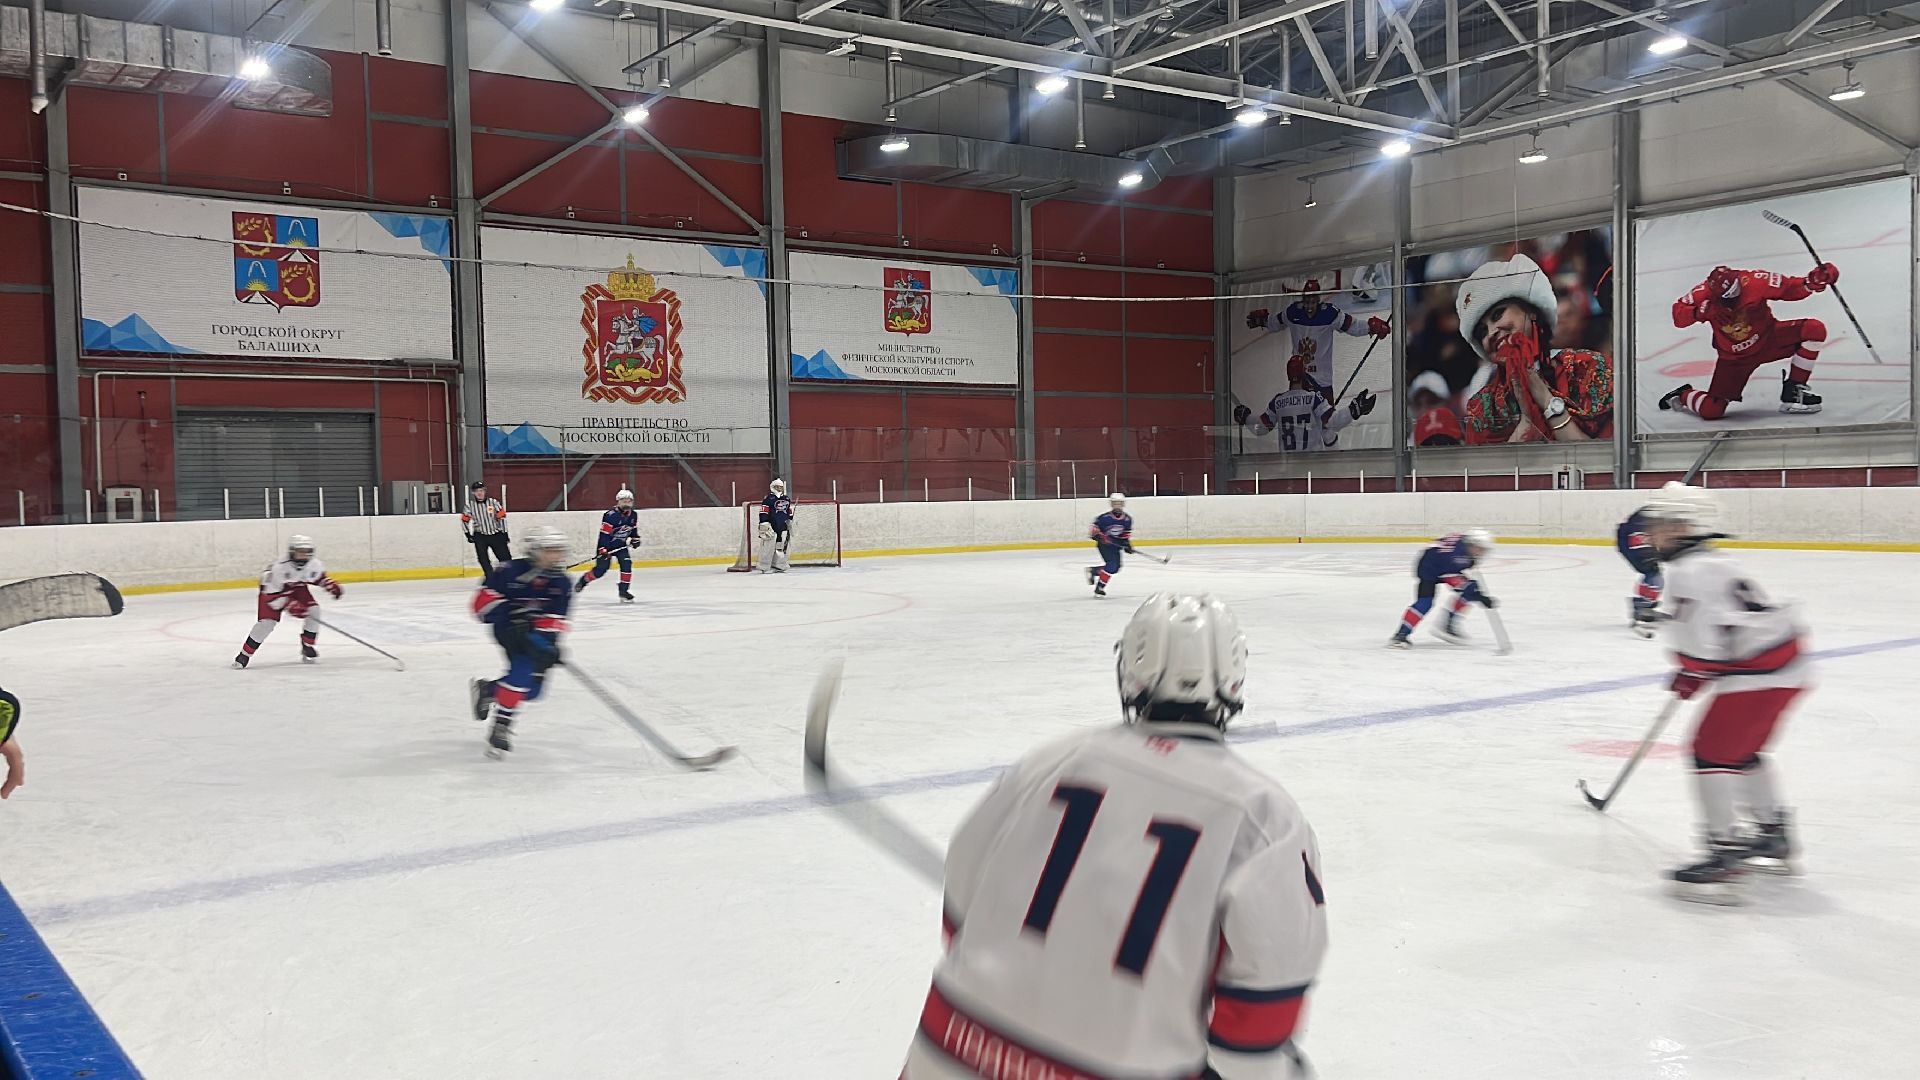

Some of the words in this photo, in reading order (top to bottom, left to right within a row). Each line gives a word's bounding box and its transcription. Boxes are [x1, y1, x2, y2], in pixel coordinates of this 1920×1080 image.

[211, 324, 297, 338] ГОРОДСКОЙ
[300, 328, 345, 340] ОКРУГ
[238, 340, 321, 353] БАЛАШИХА
[878, 343, 941, 354] МИНИСТЕРСТВО
[841, 353, 896, 364] ФИЗИЧЕСКОЙ
[897, 355, 937, 366] КУЛЬТУРЫ
[938, 357, 944, 365] И
[945, 357, 975, 366] СПОРТА
[864, 365, 920, 375] МОСКОВСКОЙ
[921, 367, 956, 376] ОБЛАСТИ
[582, 417, 689, 430] ПРАВИТЕЛЬСТВО
[559, 430, 651, 443] МОСКОВСКОЙ
[653, 432, 710, 443] ОБЛАСТИ
[1281, 413, 1312, 451] 87
[1019, 782, 1204, 986] 11
